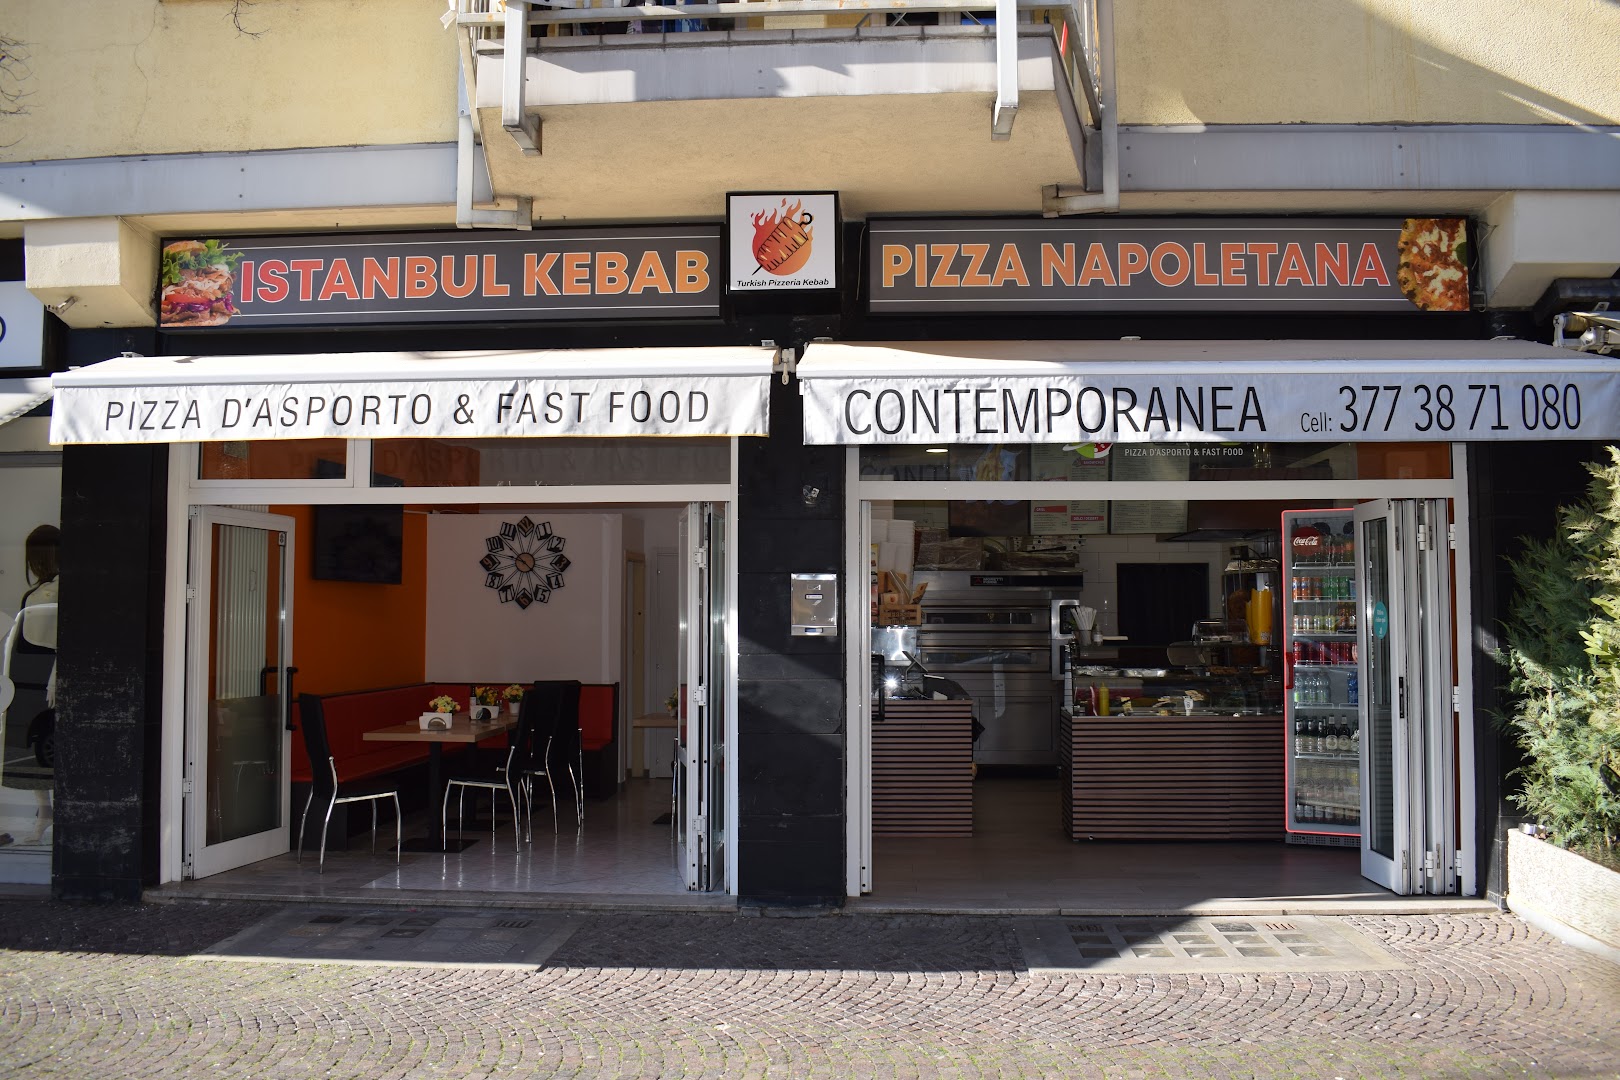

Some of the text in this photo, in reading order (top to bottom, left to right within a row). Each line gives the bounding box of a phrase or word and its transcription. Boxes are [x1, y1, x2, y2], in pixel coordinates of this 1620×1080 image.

[241, 250, 710, 304] ISTANBUL KEBAB
[737, 277, 830, 288] Turkish Pizzeria Kebab
[882, 241, 1390, 288] PIZZA NAPOLETANA
[106, 389, 710, 431] PIZZA D'ASPORTO & FAST FOOD
[845, 386, 1266, 435] CONTEMPORANEA
[1300, 384, 1580, 433] Cell: 377 38 71 080
[1124, 447, 1244, 457] PIZZA D'ASPORTO & FAST FOOD
